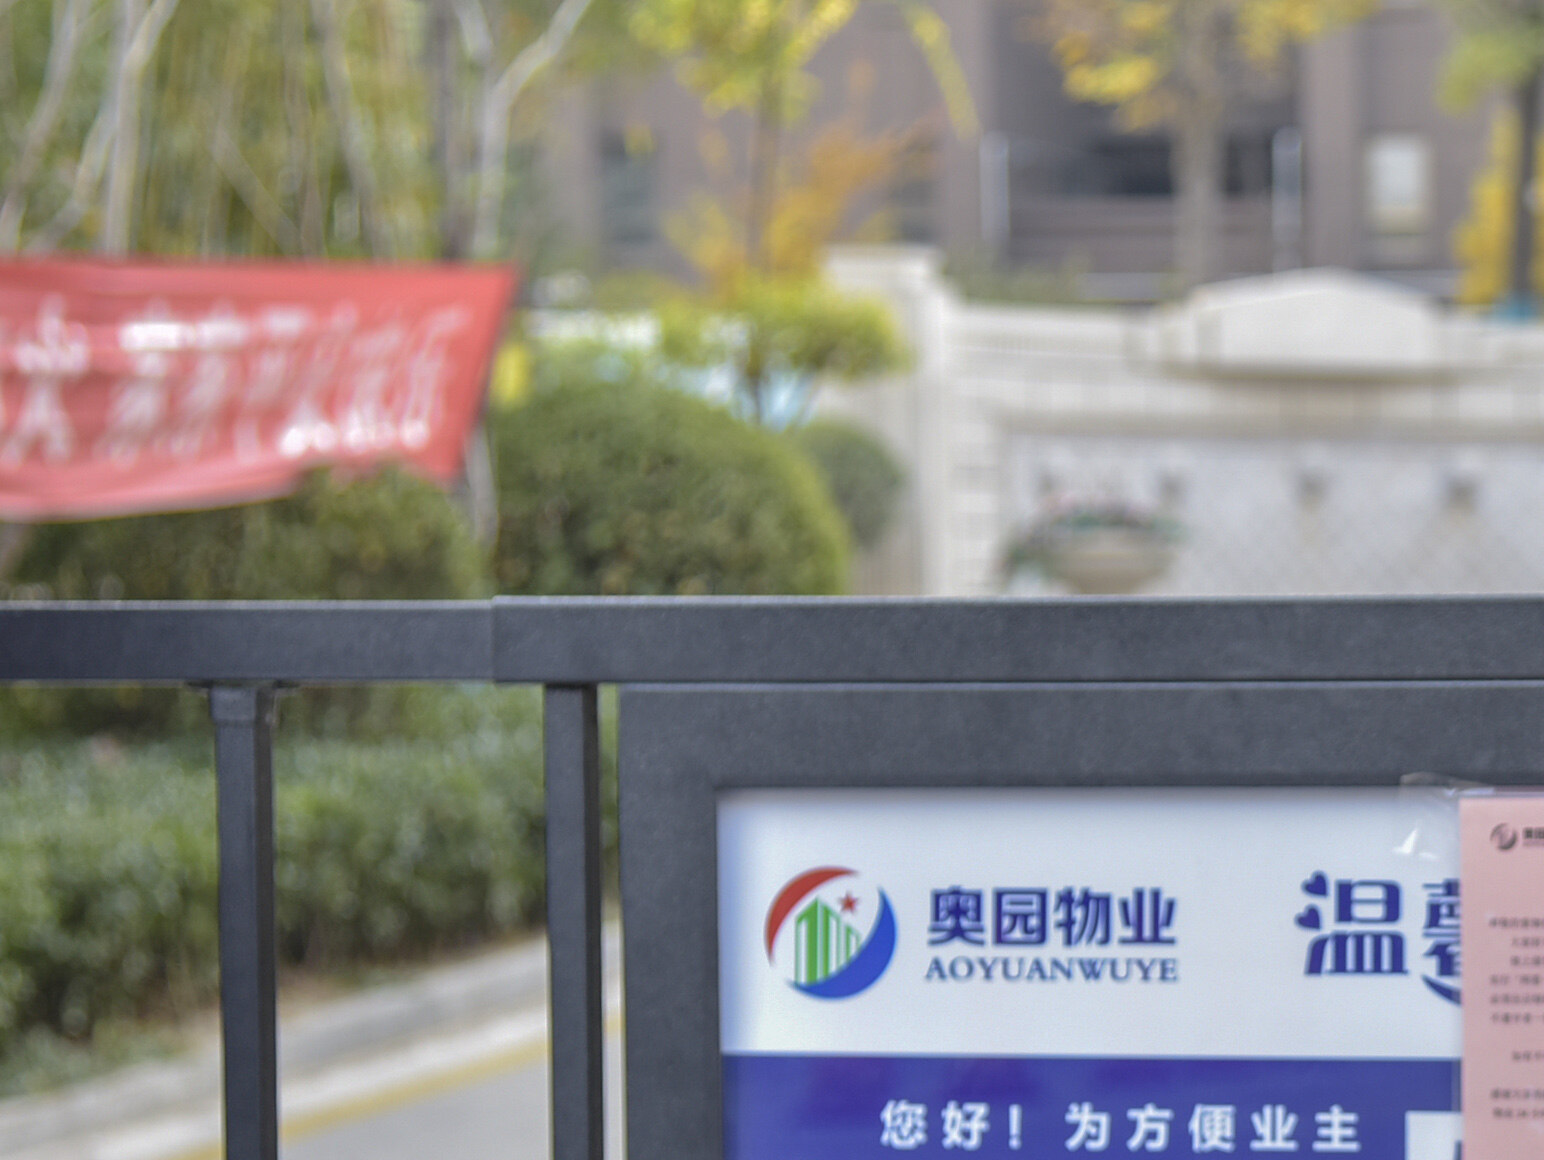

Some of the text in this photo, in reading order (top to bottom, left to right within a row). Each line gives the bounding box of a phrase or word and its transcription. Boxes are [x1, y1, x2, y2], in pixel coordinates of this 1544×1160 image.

[926, 885, 1177, 947] 奥园物业
[925, 956, 1179, 982] AOYUANWUYE
[881, 1101, 1359, 1151] 您好！为方便业主
